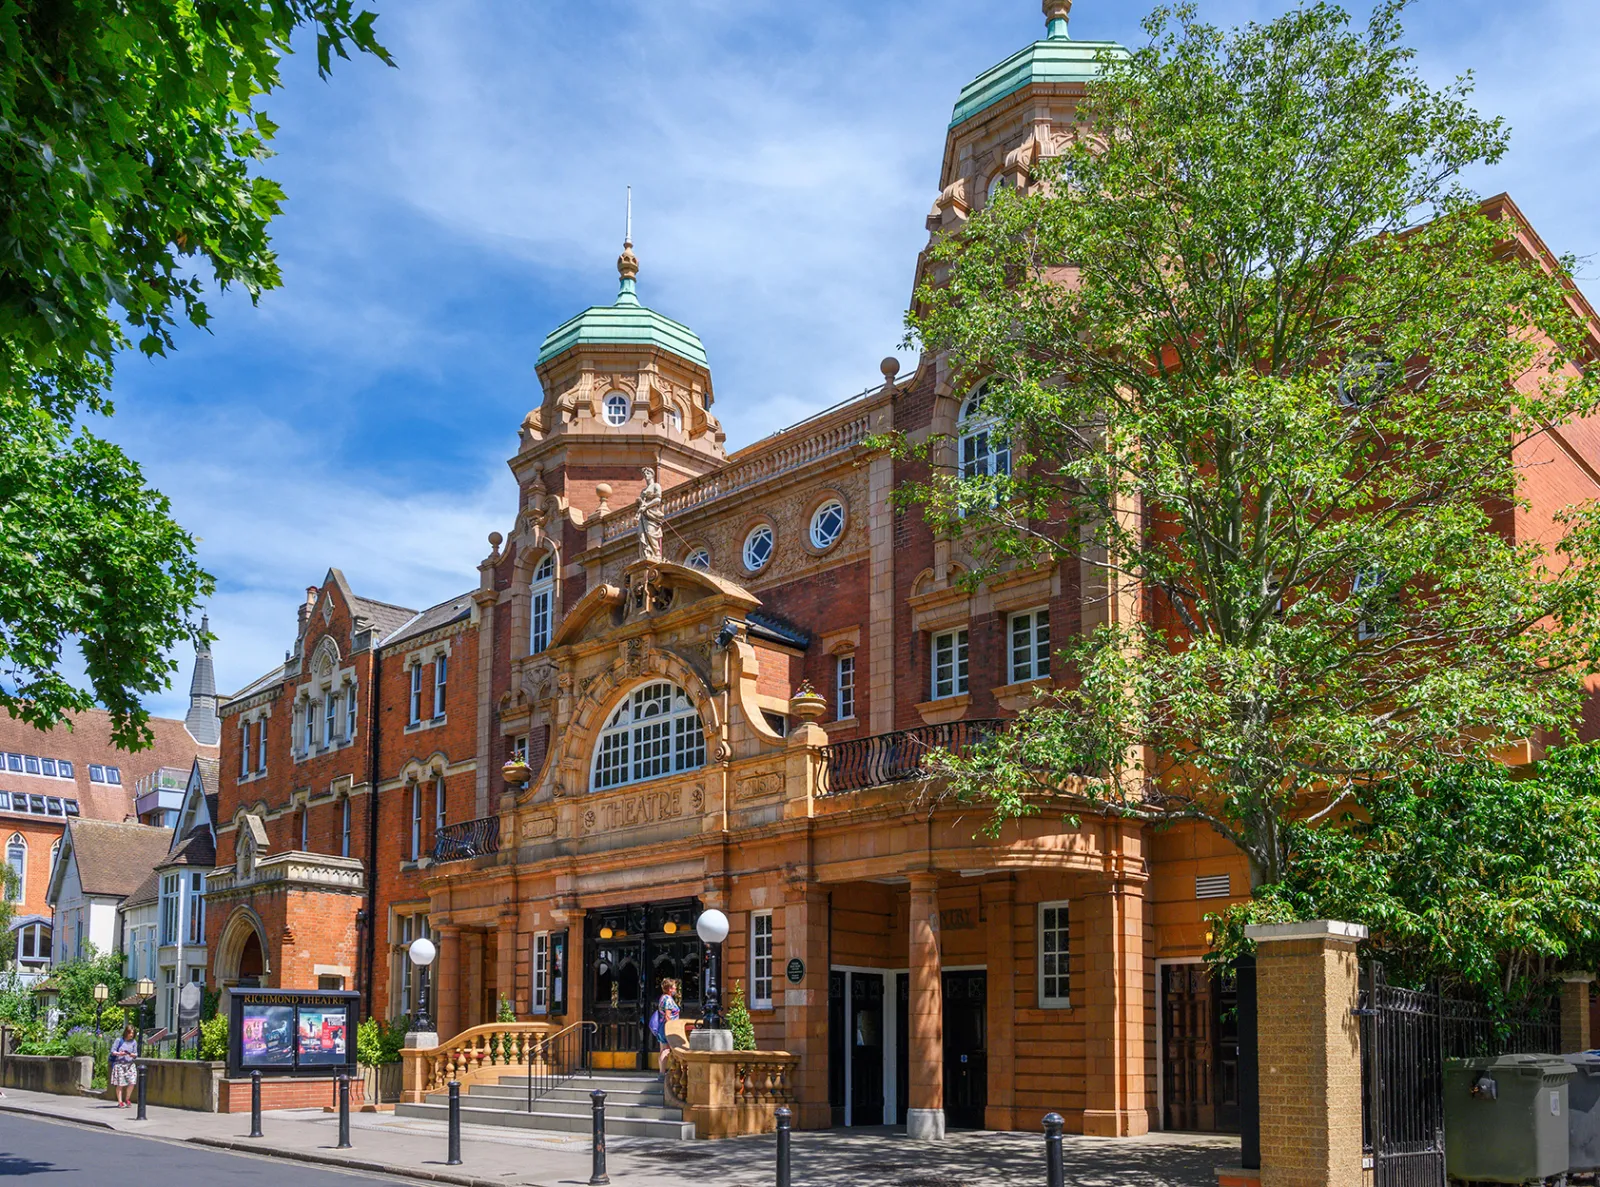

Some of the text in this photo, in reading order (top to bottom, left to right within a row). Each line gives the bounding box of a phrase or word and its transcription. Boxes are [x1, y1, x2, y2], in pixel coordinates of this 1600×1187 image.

[601, 788, 683, 830] THEATRE
[244, 994, 344, 1004] RICHMOND THEATRE
